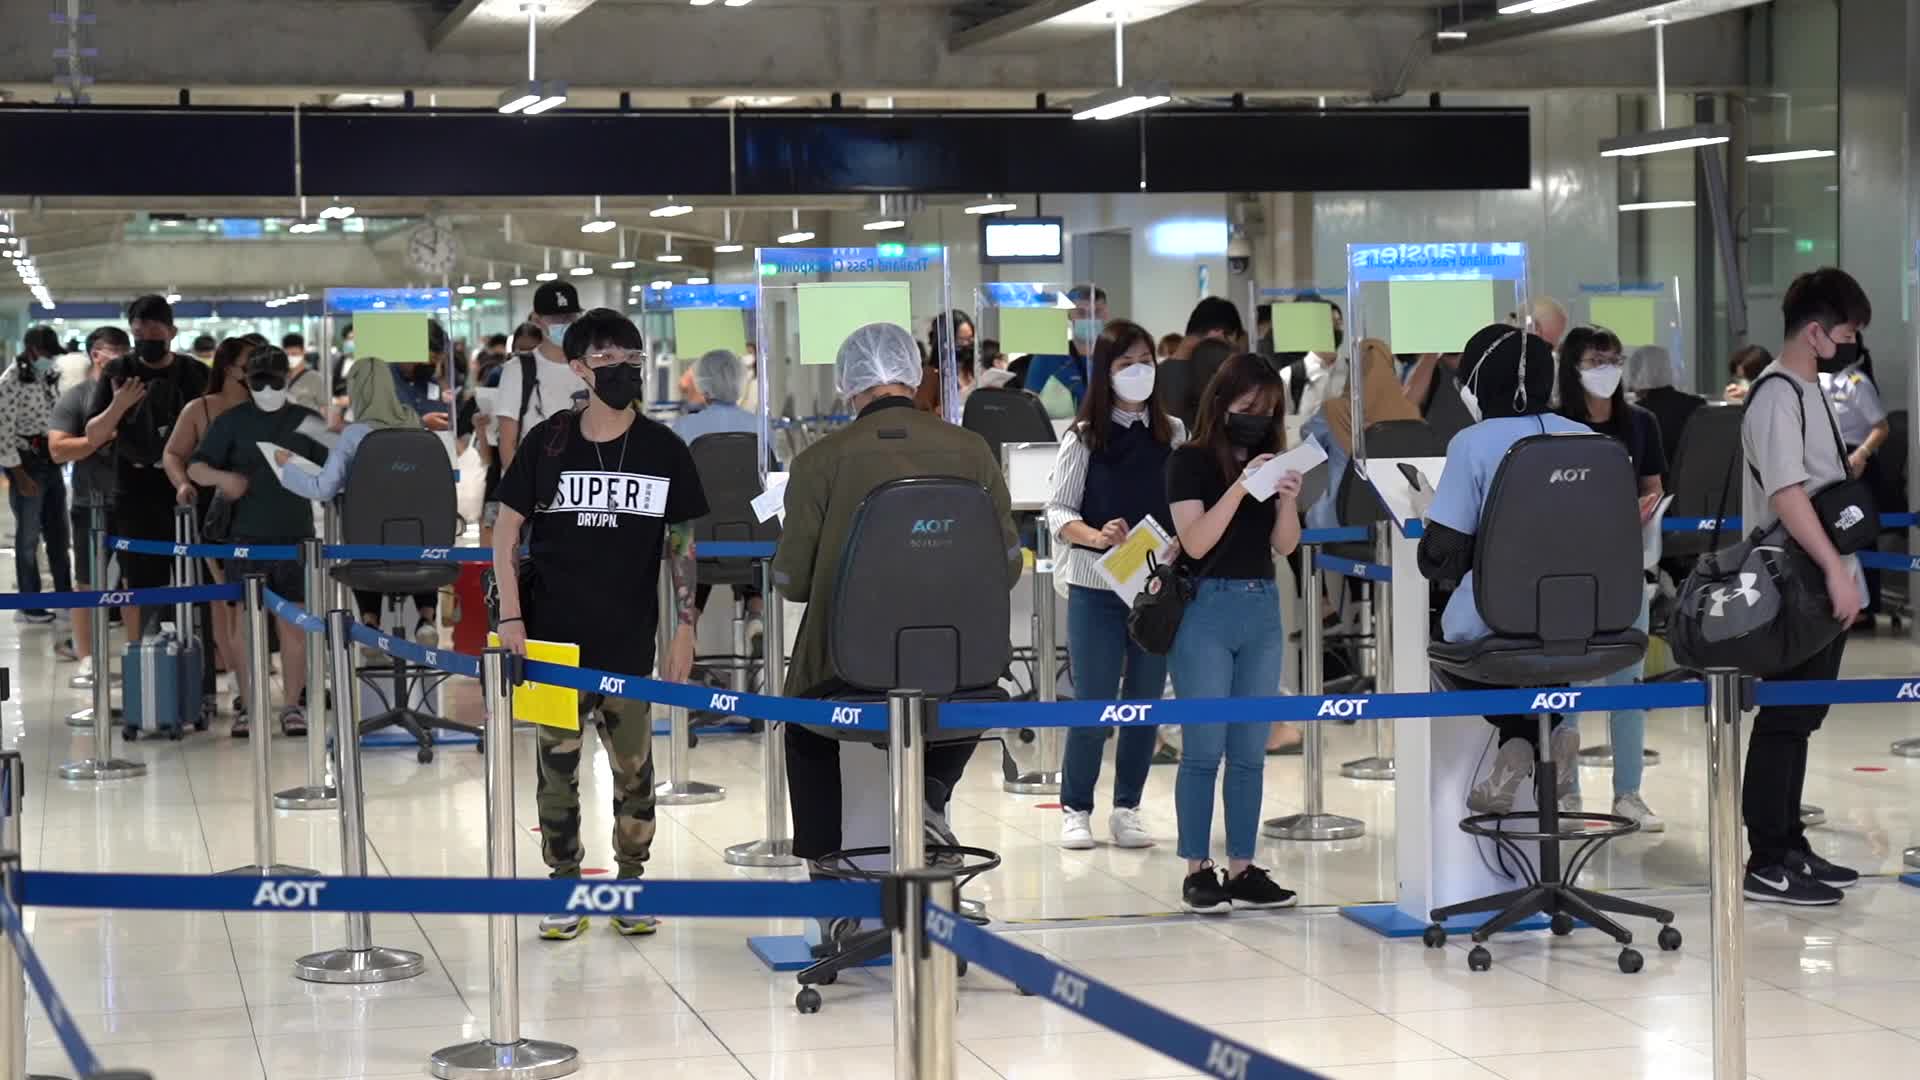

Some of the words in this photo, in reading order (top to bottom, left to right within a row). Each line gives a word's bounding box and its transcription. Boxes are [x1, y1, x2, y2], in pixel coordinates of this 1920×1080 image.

[1550, 468, 1591, 483] AOT
[557, 477, 639, 508] SUPER
[912, 519, 955, 534] AOT
[421, 549, 449, 559] AOT
[99, 591, 134, 604] AOT
[600, 676, 625, 694] AOT
[709, 693, 739, 711] AOT
[1317, 699, 1369, 716] AOT
[1530, 691, 1582, 709] AOT
[831, 707, 862, 724] AOT
[1100, 704, 1152, 722] AOT
[253, 880, 327, 907] AOT
[566, 883, 643, 911] AOT
[1051, 972, 1088, 1008] AOT
[1206, 1040, 1250, 1080] AOT
